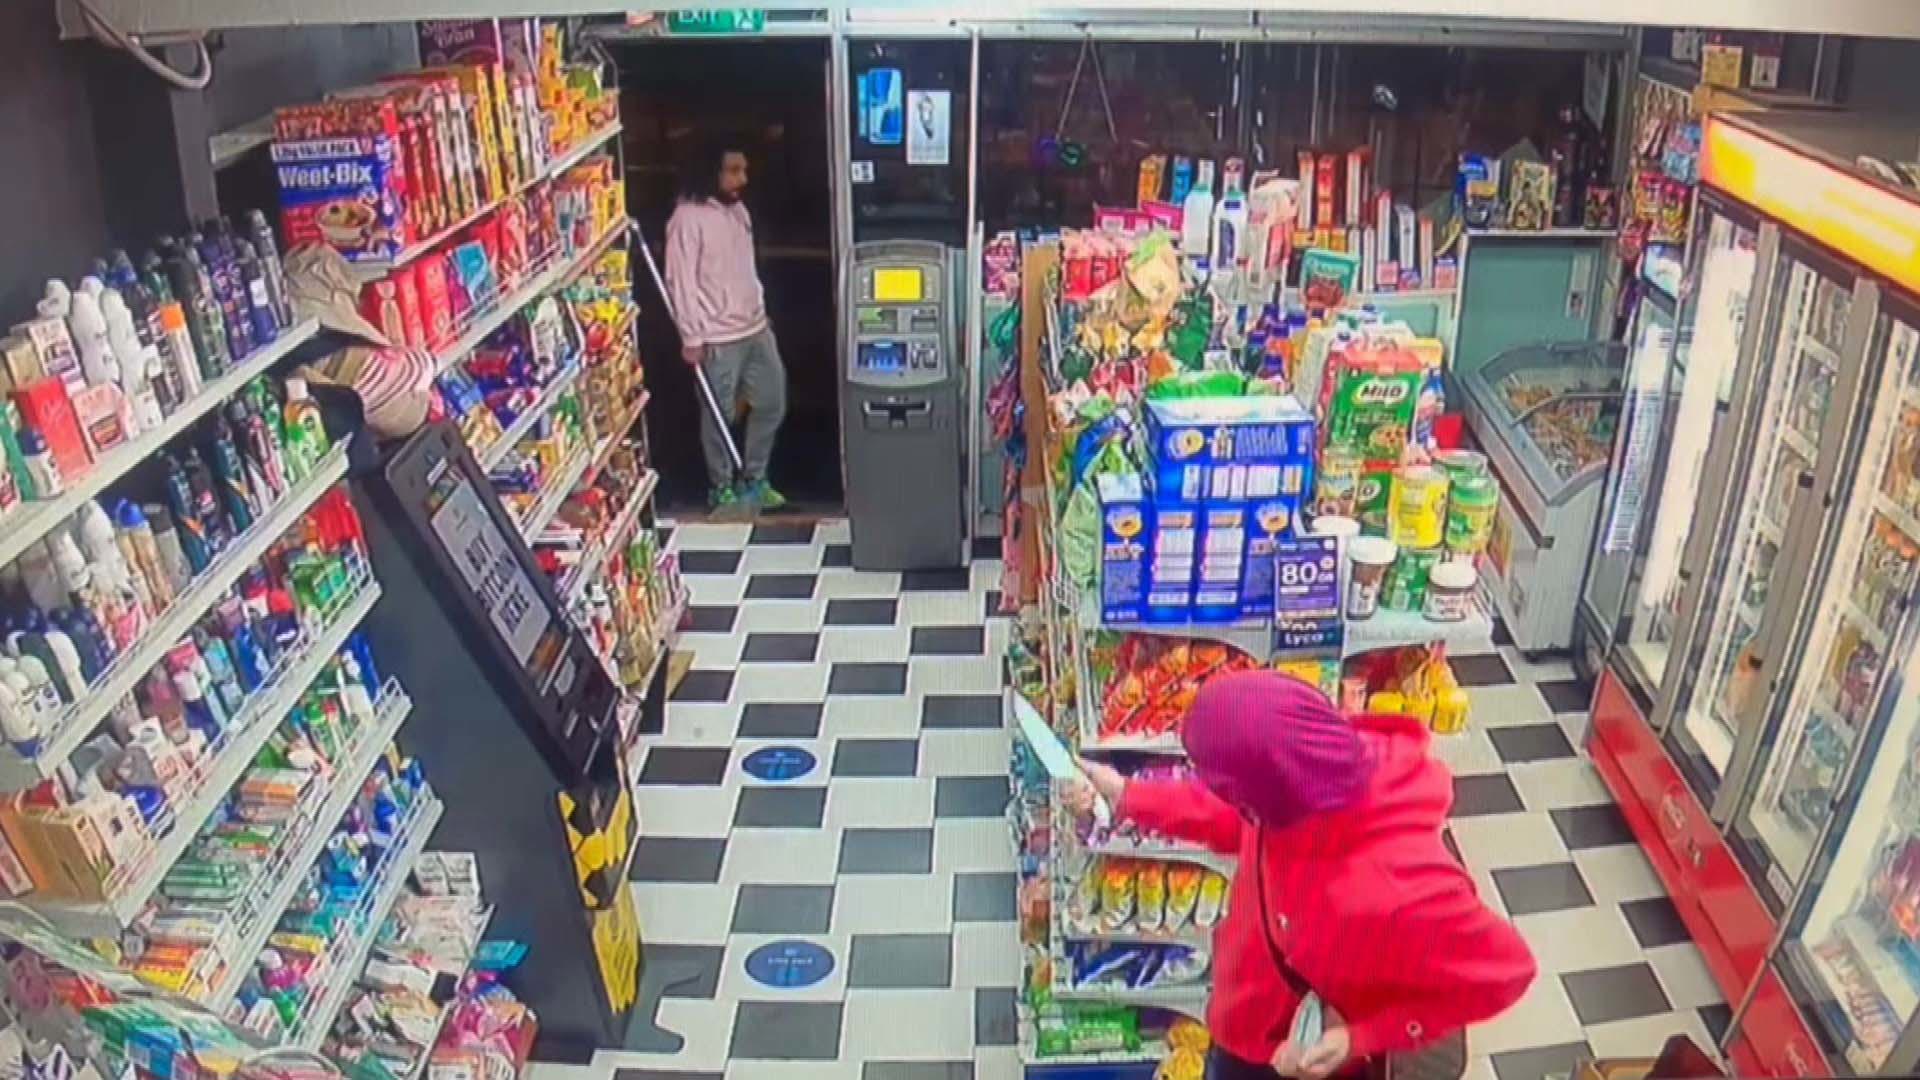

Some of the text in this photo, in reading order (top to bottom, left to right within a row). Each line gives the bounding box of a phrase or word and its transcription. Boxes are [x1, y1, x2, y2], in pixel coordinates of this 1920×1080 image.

[278, 162, 372, 188] Weet-Bix
[465, 530, 493, 573] BUY
[478, 553, 518, 609] BITCOIN
[1282, 562, 1318, 585] 80
[500, 584, 530, 635] HERE
